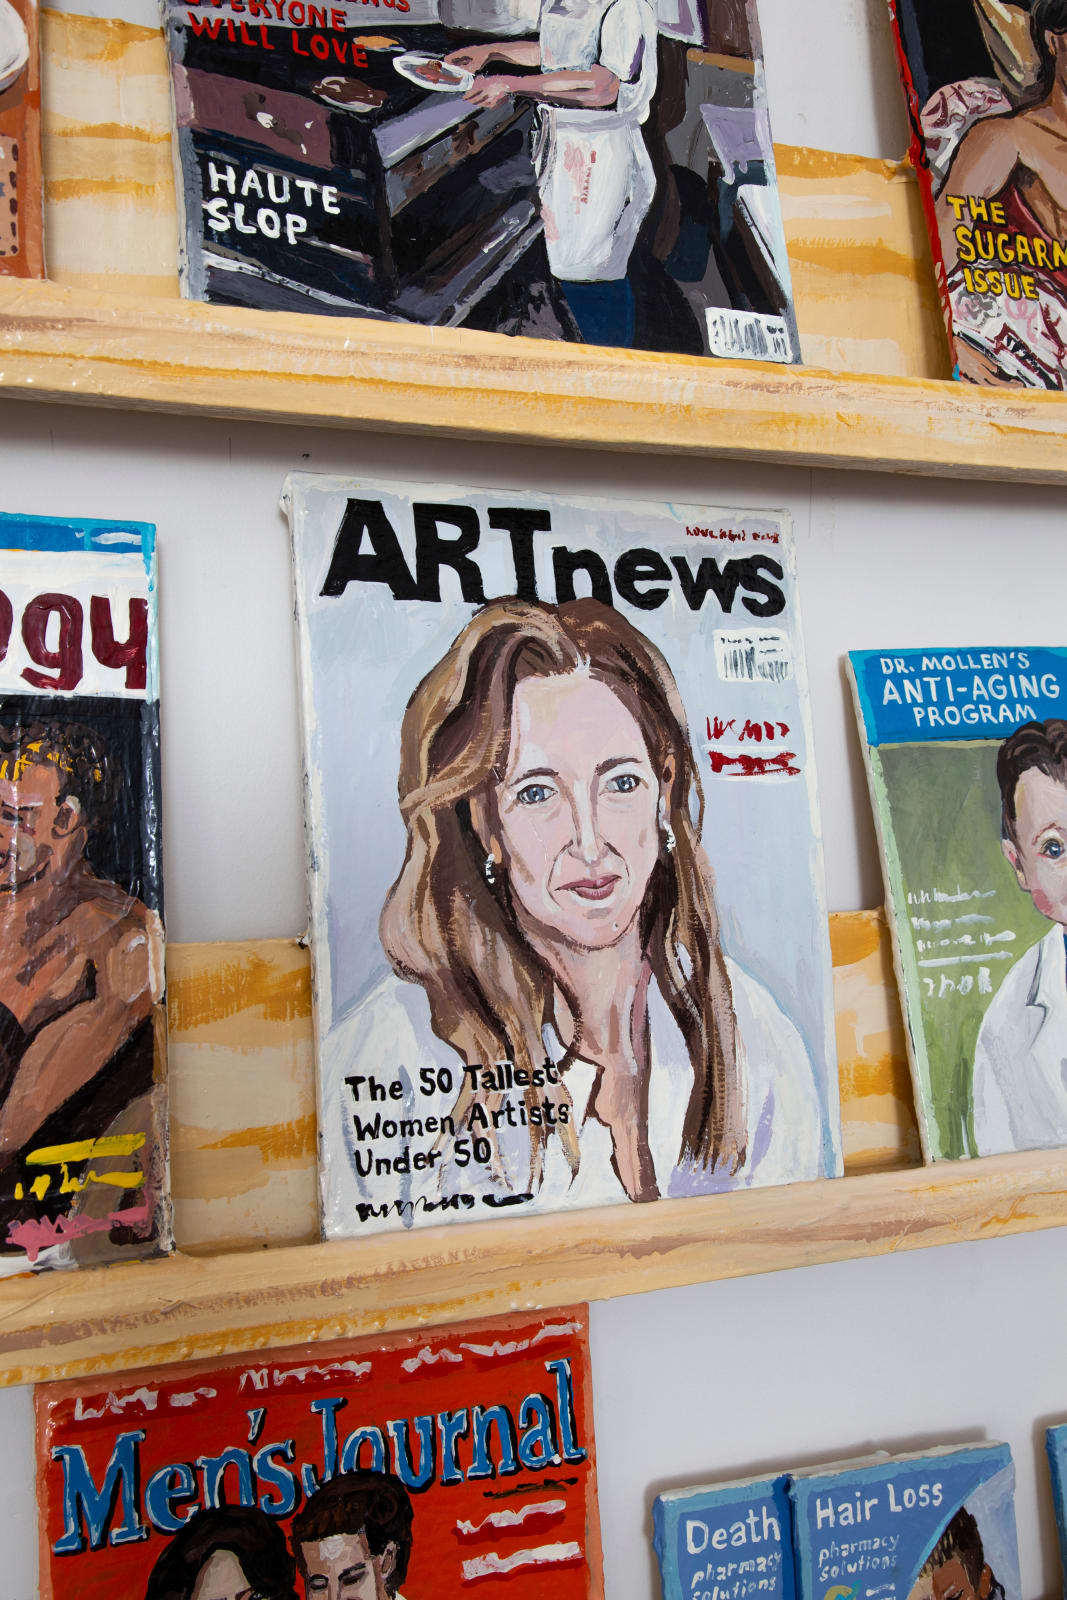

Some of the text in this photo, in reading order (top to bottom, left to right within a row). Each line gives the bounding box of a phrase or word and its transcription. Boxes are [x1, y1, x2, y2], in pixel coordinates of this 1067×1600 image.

[184, 0, 347, 32] RYONE
[187, 11, 369, 68] WILL LOVE
[208, 161, 341, 215] HAUTE
[207, 197, 308, 245] SLOP
[946, 194, 1008, 227] THE
[962, 266, 1040, 301] ISSUE
[319, 497, 787, 617] ARTnews
[0, 588, 148, 691] gy
[880, 652, 1030, 675] DR. MOLLEN'S
[882, 673, 1061, 705] ANTI-AGING
[913, 703, 1037, 727] PROGRAM
[345, 1057, 560, 1101] The 50 Tallest
[353, 1096, 570, 1141] Women Artists
[354, 1137, 492, 1177] Under 50
[52, 1358, 587, 1556] Men's Journal
[816, 1482, 943, 1530] Hair Loss
[686, 1505, 781, 1554] Death
[691, 1551, 781, 1589] pharmacy
[818, 1534, 900, 1568] pharmacy
[819, 1554, 897, 1582] solutions
